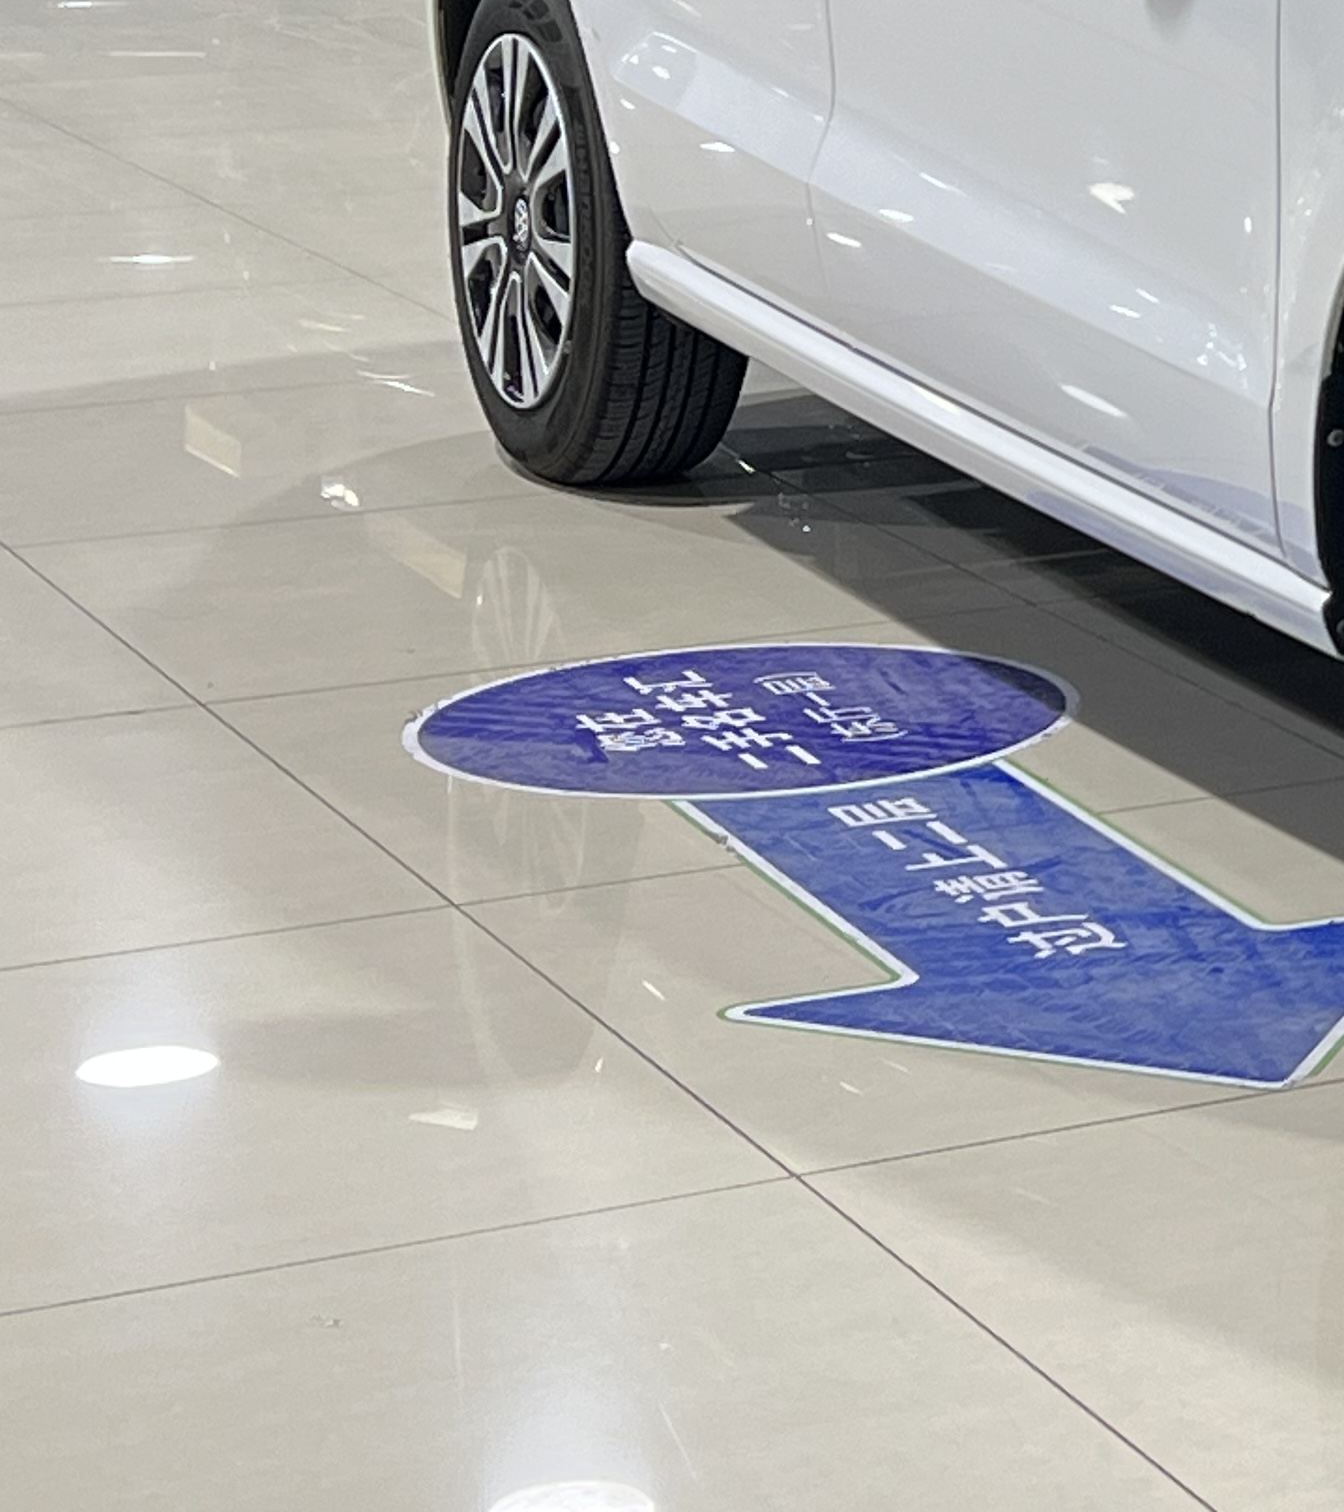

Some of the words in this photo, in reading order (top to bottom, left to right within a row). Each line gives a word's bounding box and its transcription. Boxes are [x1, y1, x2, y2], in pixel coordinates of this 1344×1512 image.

[623, 670, 823, 769] 二手名车汇
[827, 797, 1129, 959] 过户请上二层
